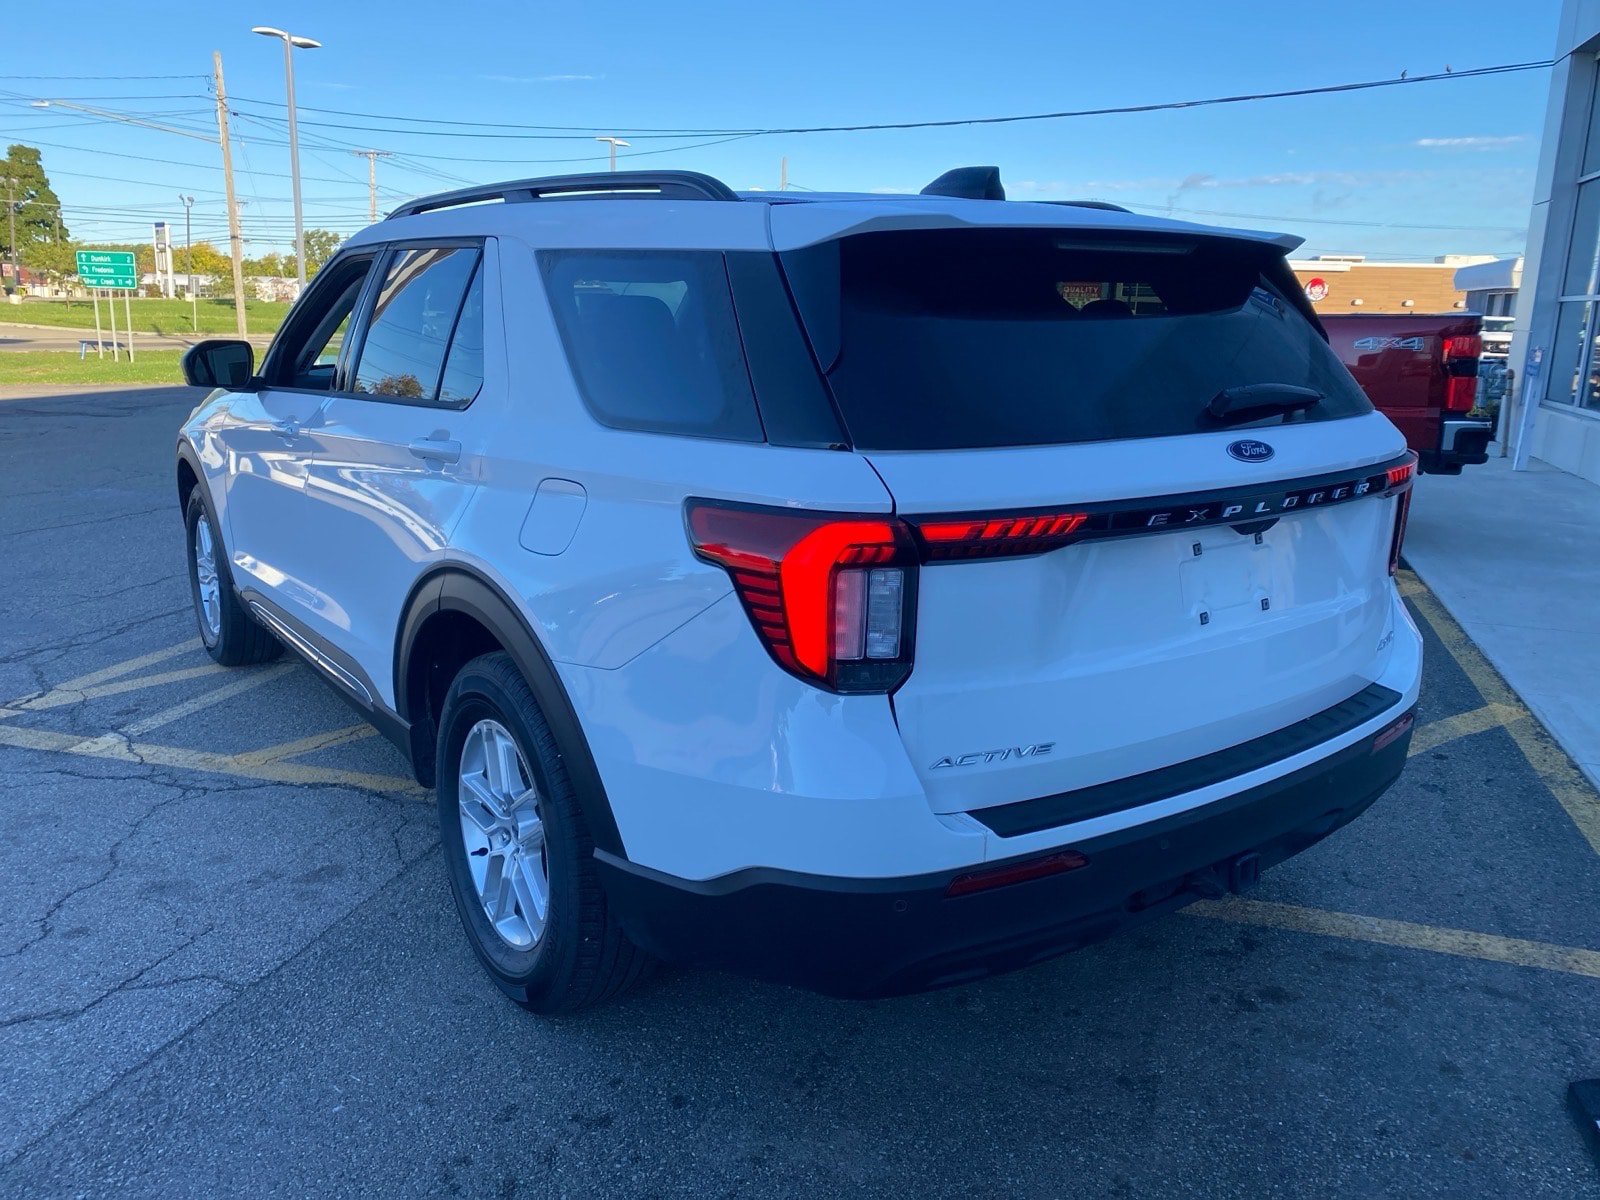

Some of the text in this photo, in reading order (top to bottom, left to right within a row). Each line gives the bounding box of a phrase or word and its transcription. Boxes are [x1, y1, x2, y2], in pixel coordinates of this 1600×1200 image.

[90, 255, 131, 264] Dunkirk 2
[91, 266, 114, 274] Fredonia
[1240, 442, 1268, 456] Ford
[1147, 481, 1370, 527] EXPLORER
[929, 741, 1056, 770] ACTIVE
